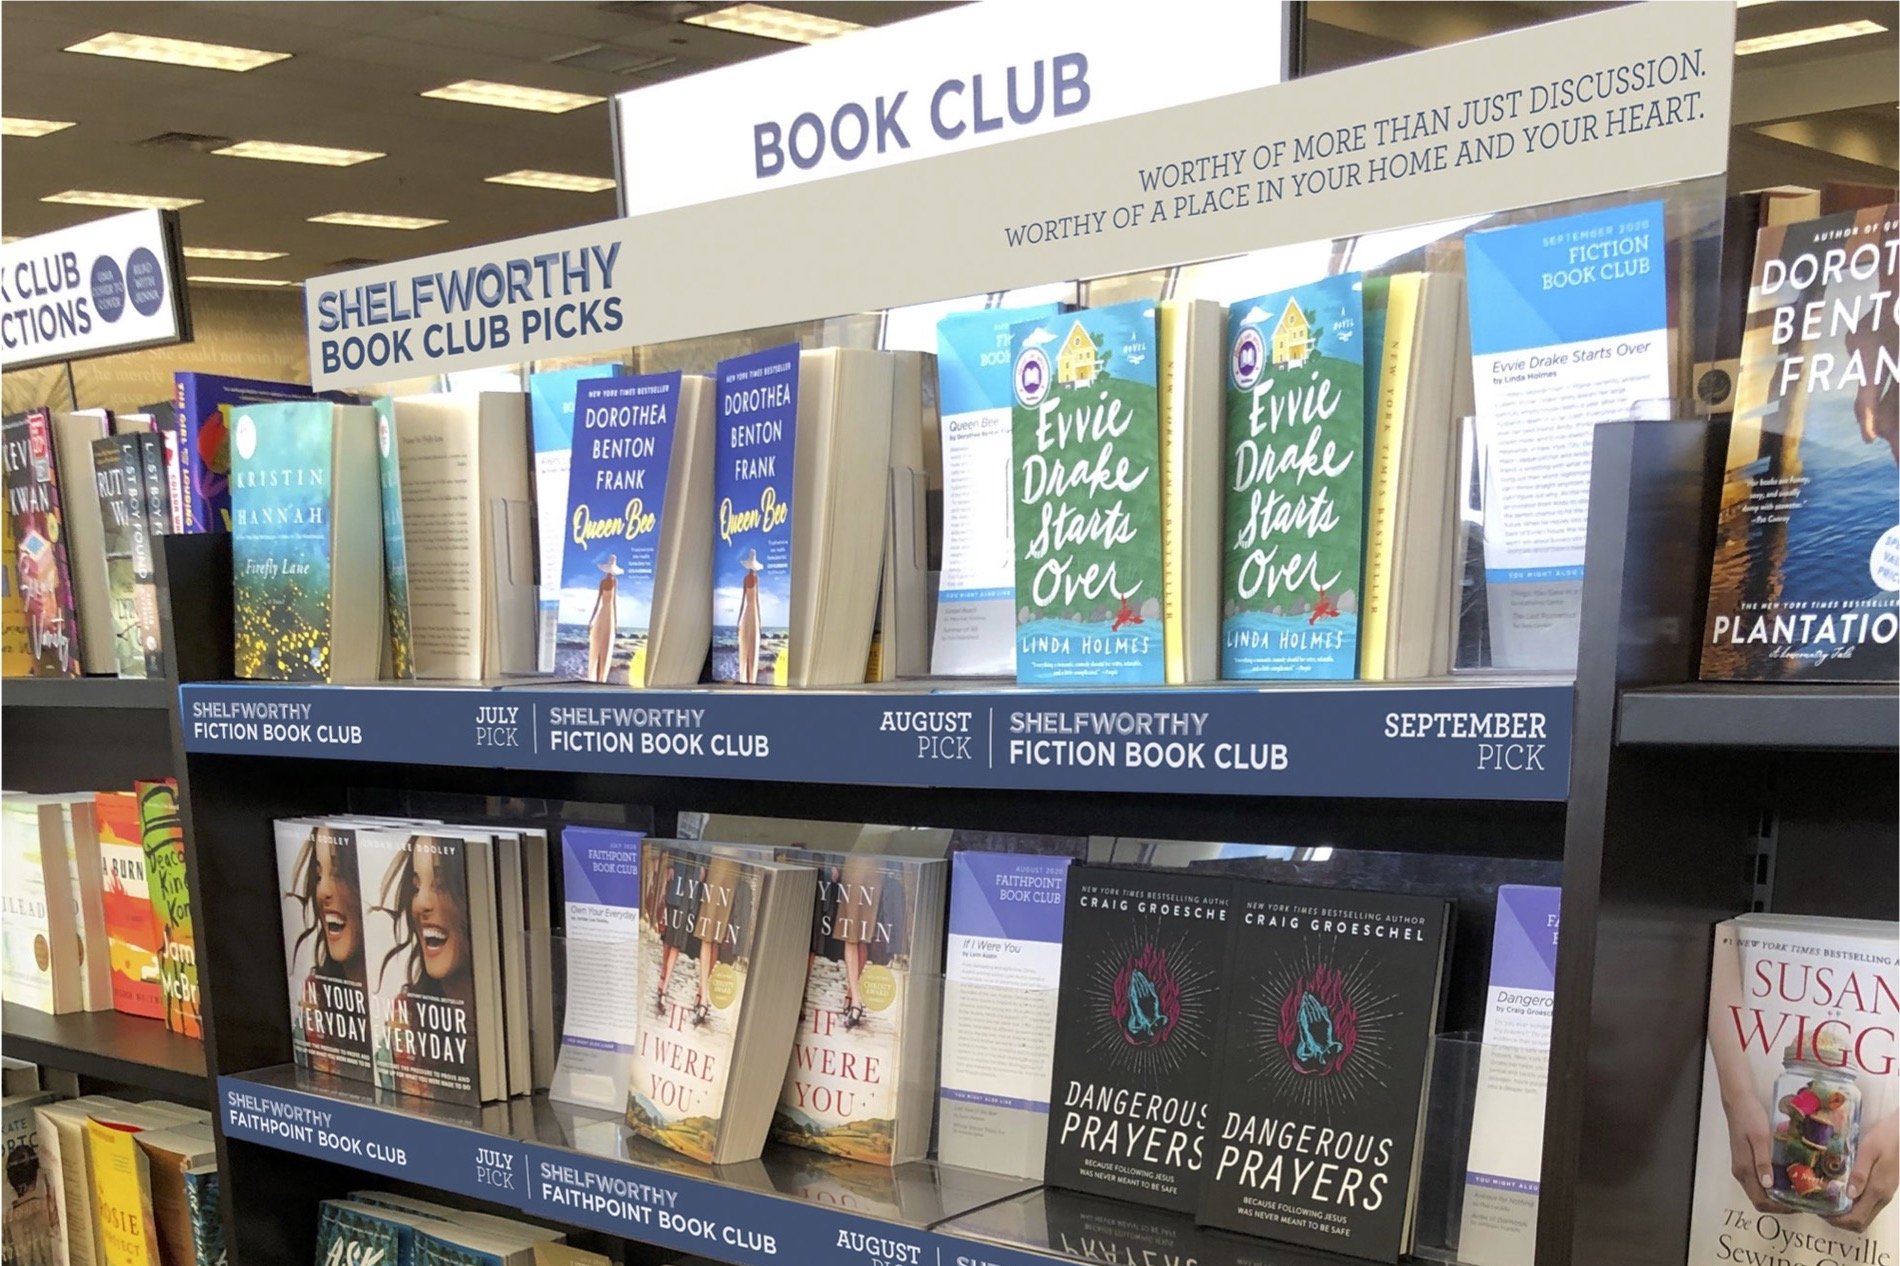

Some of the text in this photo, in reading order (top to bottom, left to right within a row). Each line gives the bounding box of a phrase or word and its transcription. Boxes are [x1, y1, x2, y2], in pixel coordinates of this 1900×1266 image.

[753, 52, 1091, 179] BOOK CLUB
[1139, 49, 1706, 192] WORTHY OF MORE THAN JUST DISCUSSION.
[1005, 92, 1704, 247] WORTHY OF A PLACE IN YOUR HOME AND YOUR HEART.
[1569, 235, 1649, 264] FICTION
[15, 251, 81, 299] CLUB
[317, 242, 622, 333] SHELFWORTHY
[1542, 257, 1650, 290] BOOK CLUB
[321, 296, 623, 374] BOOK CLUB PICKS
[1493, 341, 1651, 373] Evvie Drake Starts Over
[585, 403, 667, 429] DOROTHEA
[1035, 390, 1133, 452] Evvie
[592, 437, 655, 459] BENTON
[237, 467, 324, 488] KRISTIN
[596, 469, 646, 490] FRANK
[1021, 442, 1149, 506] Drake
[10, 483, 49, 516] KWAN
[237, 507, 323, 525] HANNAH
[1025, 500, 1137, 560] Starts
[1032, 555, 1143, 607] Over
[1022, 636, 1150, 655] LINDA HOLMES
[193, 702, 311, 720] SHELFWORTHY
[476, 707, 519, 724] JULY
[550, 707, 704, 728] SHELFWORTHY
[879, 711, 972, 732] AUGUST
[1009, 712, 1208, 736] SHELFWORTHY
[194, 722, 362, 744] FICTION BOOK CLUB
[476, 727, 519, 747] PICK
[1385, 713, 1547, 739] SEPTEMBER
[551, 731, 769, 757] FICTION BOOK CLUB
[917, 736, 972, 759] PICK
[1010, 741, 1289, 771] FICTION BOOK CLUB
[1477, 745, 1545, 771] PICK
[995, 875, 1062, 889] FAITHPOINT
[1000, 889, 1061, 904] BOOK CLUB
[1244, 913, 1424, 942] CRAIG GROESCHEL
[227, 1091, 332, 1128] SHELFWORTHY
[230, 1110, 407, 1166] FAITHPOINT BOOK CLUB
[1222, 1112, 1394, 1168] DANGEROUS
[476, 1148, 514, 1170] JULY
[476, 1166, 514, 1190] PICK
[540, 1162, 678, 1208] SHELFWORTHY
[1216, 1146, 1389, 1212] PRAYERS
[542, 1184, 777, 1255] FAITHPOINT BOOK CLUB
[1723, 1207, 1754, 1233] The
[837, 1230, 921, 1264] AUGUST
